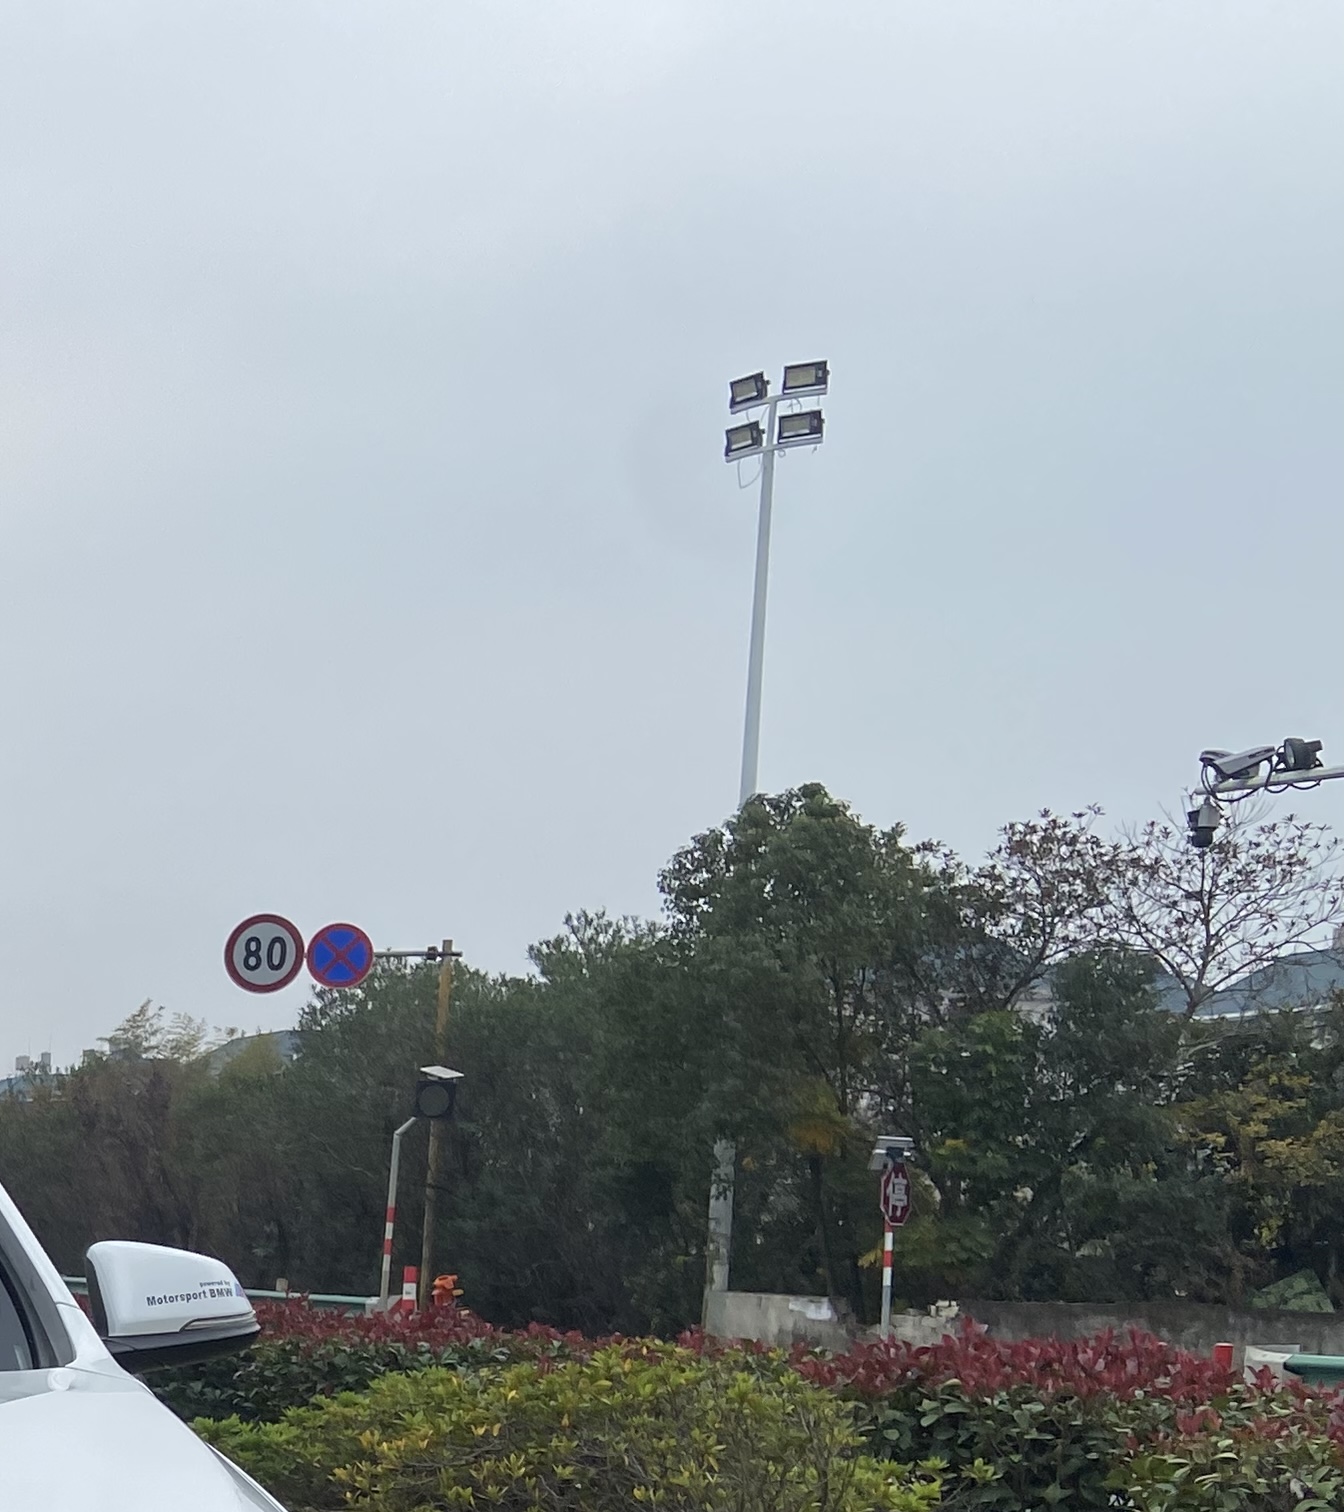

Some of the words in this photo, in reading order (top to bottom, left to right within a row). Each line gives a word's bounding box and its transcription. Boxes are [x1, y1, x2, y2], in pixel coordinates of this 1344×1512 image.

[243, 936, 287, 971] 80
[146, 1290, 208, 1306] Motorsport
[209, 1288, 233, 1298] BMW
